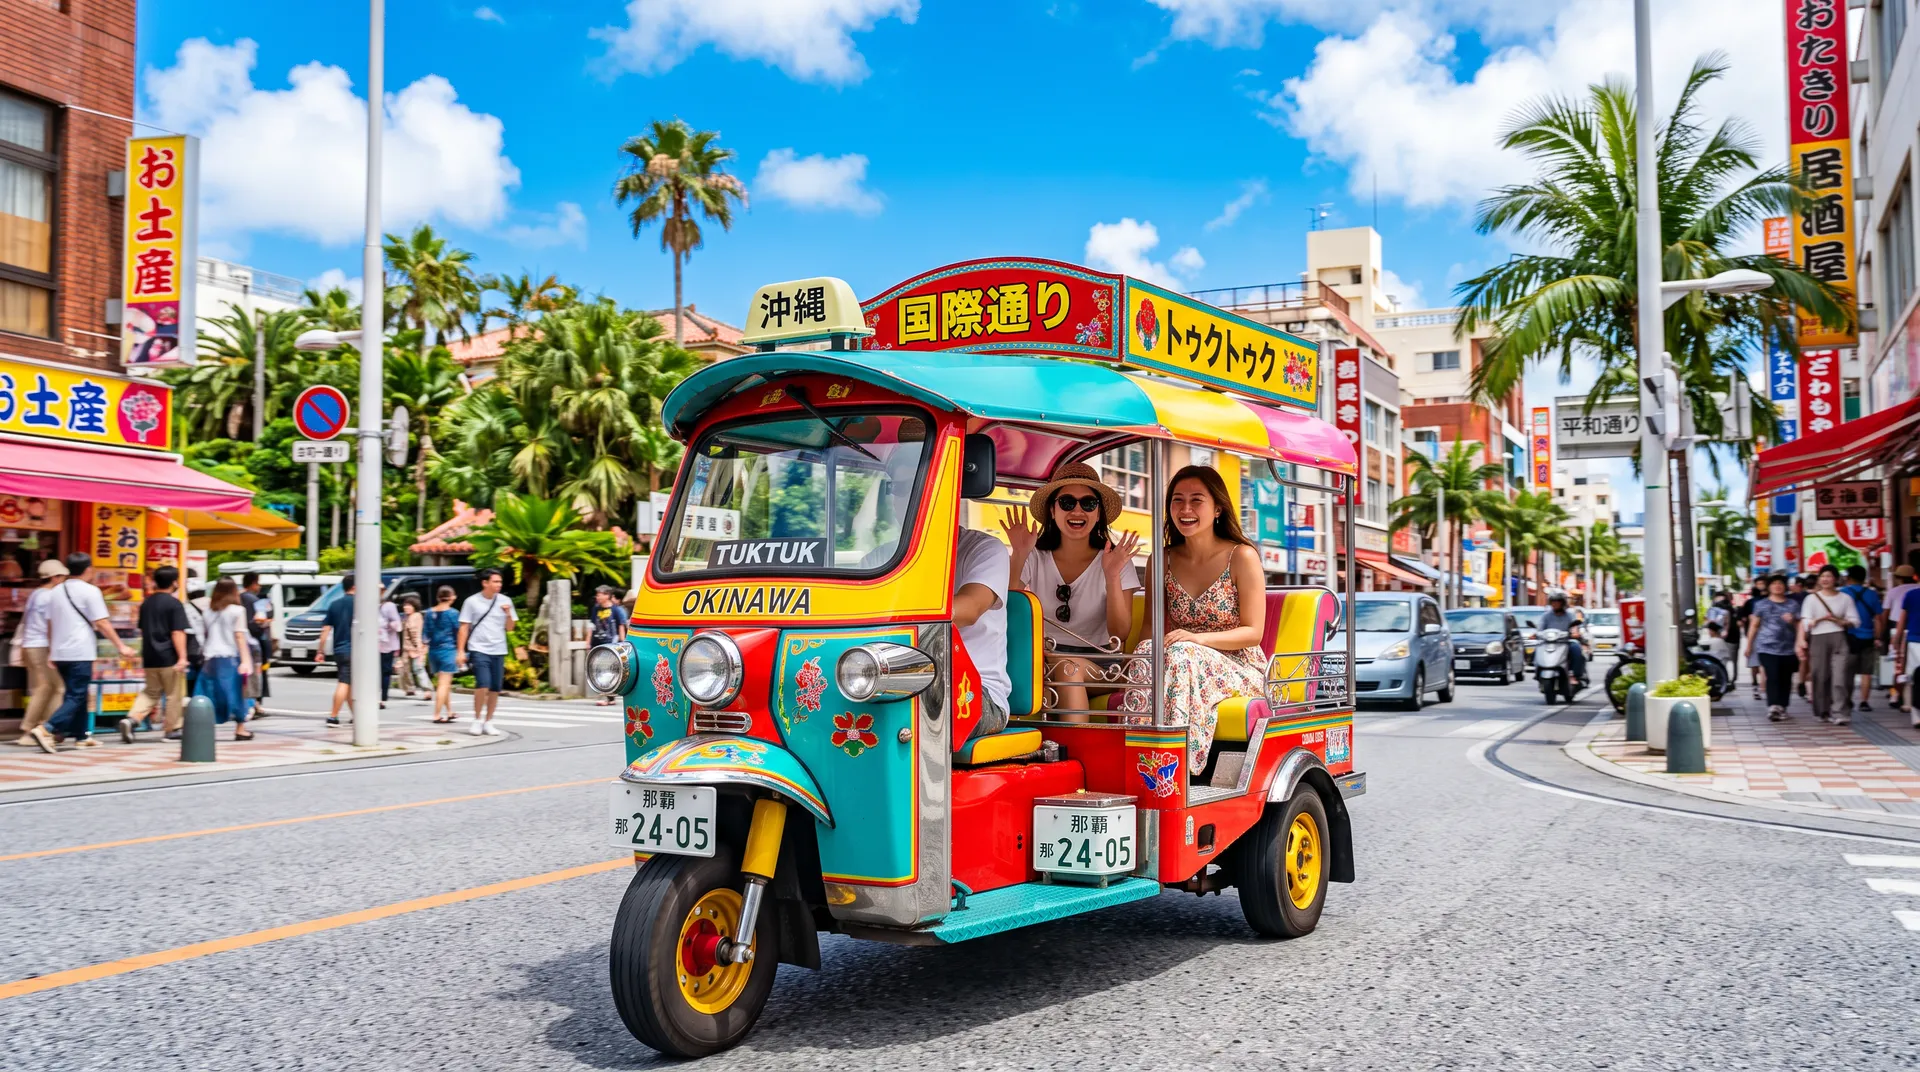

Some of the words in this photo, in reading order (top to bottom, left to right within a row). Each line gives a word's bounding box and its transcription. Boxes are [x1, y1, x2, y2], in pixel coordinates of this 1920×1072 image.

[134, 147, 175, 295] お土産
[1800, 147, 1848, 282] 居酒屋
[760, 286, 826, 329] 沖縄
[897, 281, 1071, 345] 国際通り
[1165, 309, 1276, 383] トゥクトゥク
[1562, 415, 1640, 437] 平和通り
[716, 541, 820, 565] TUKTUK
[682, 587, 811, 615] OKINAWA
[642, 789, 676, 810] 那覇
[615, 817, 628, 835] 那
[631, 811, 709, 851] 24-05
[1071, 815, 1108, 835] 那覇
[1039, 842, 1054, 859] 那
[1057, 836, 1131, 869] 24-05
